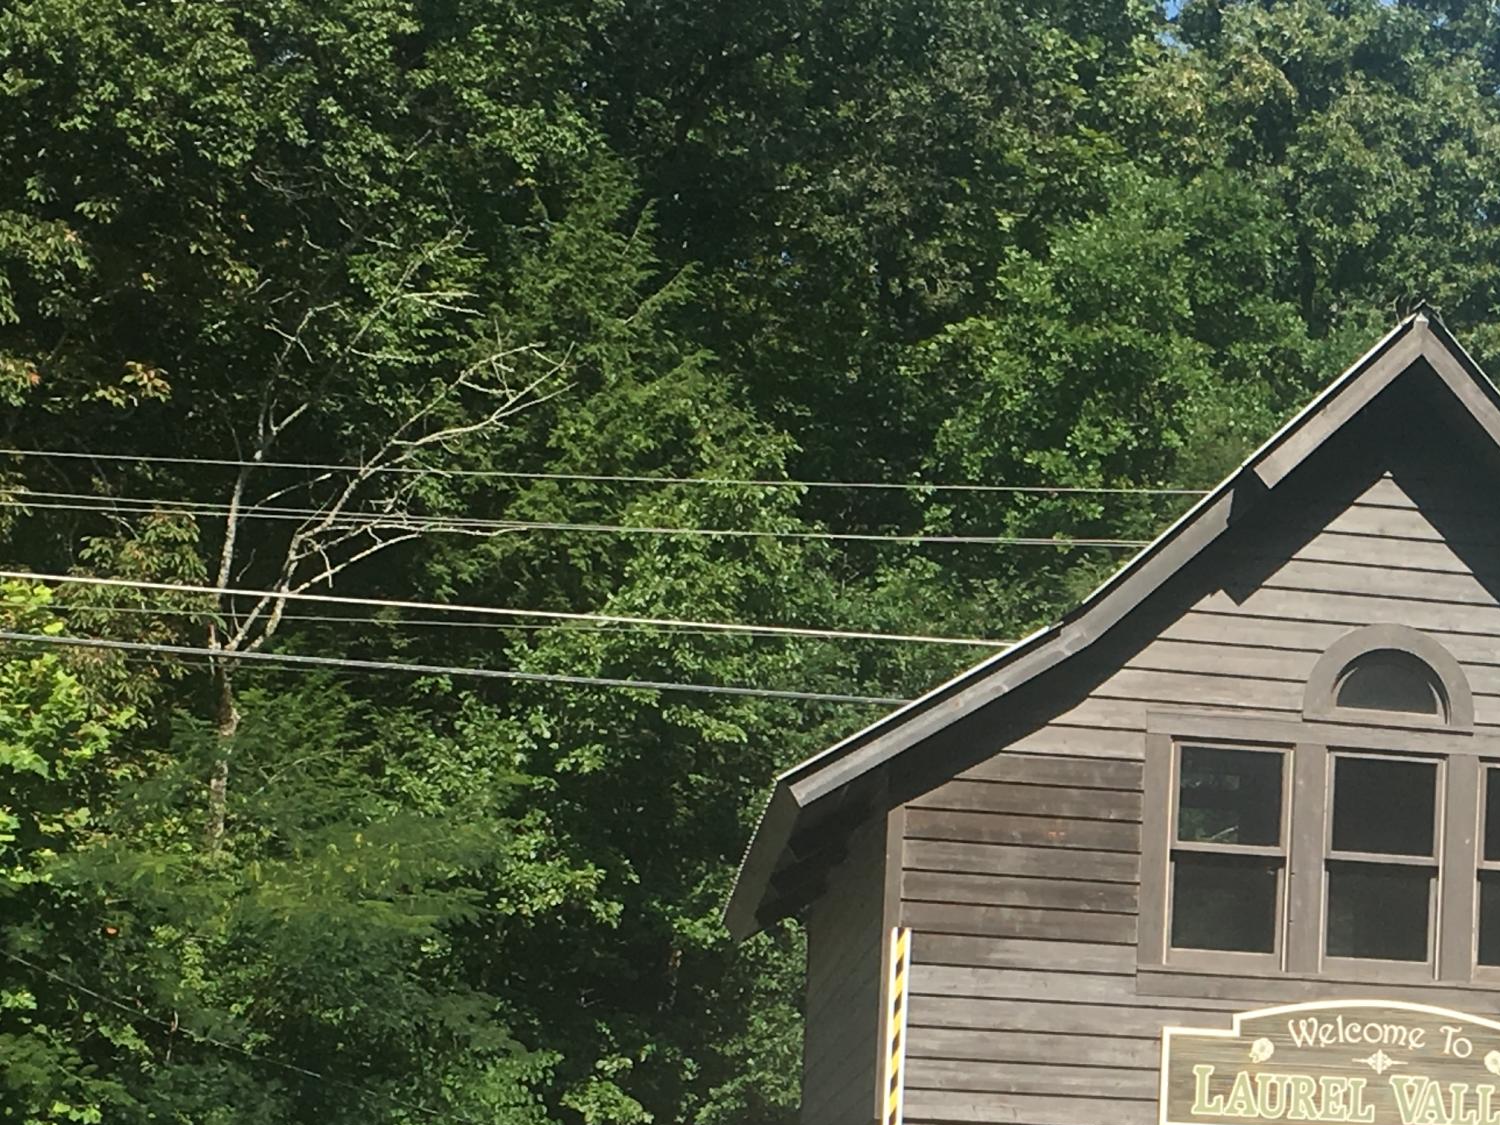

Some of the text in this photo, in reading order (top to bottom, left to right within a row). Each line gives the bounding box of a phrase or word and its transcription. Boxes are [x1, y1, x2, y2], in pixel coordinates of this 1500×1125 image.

[1287, 1015, 1473, 1059] Welcome To
[1190, 1064, 1376, 1124] LAUREL
